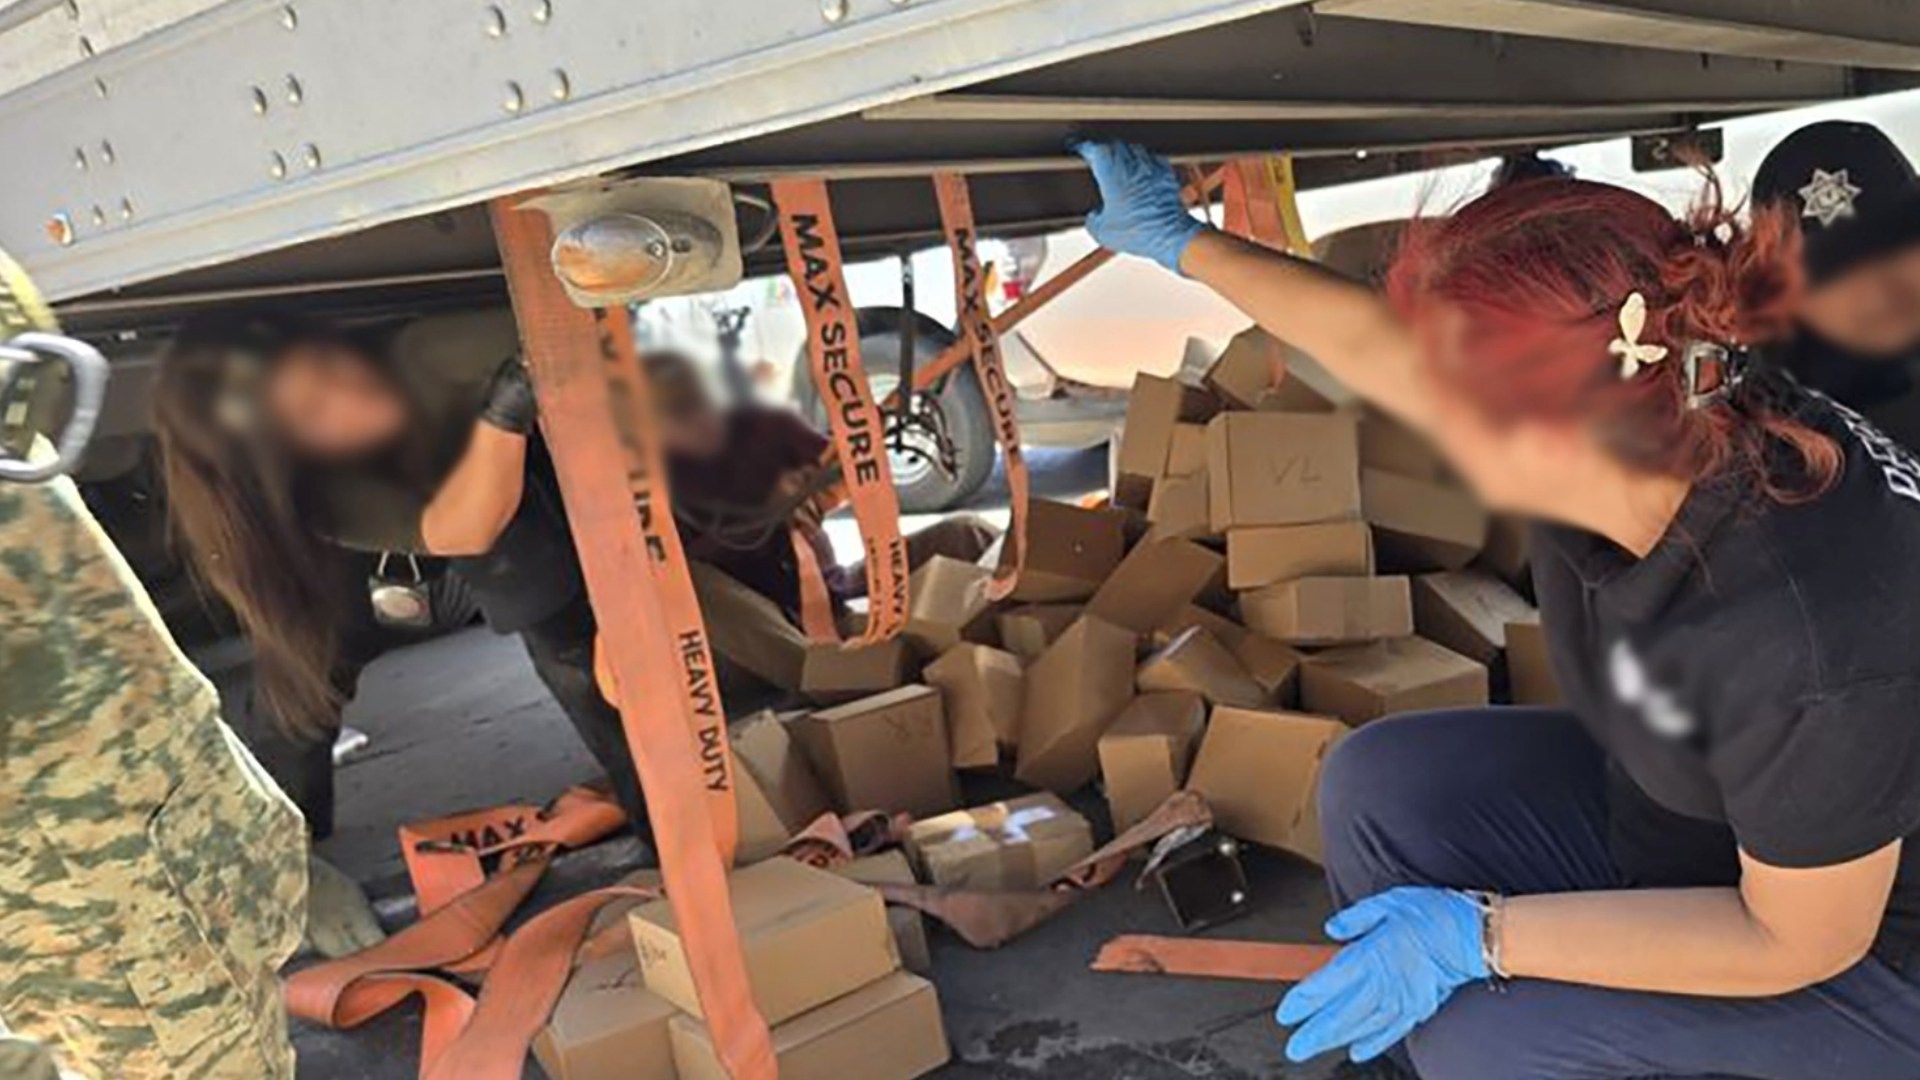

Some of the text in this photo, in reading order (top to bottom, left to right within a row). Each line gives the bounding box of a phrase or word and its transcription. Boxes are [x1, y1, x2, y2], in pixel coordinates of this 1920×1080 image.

[955, 228, 979, 313] MAX
[791, 214, 880, 486] MAX SECURE
[679, 630, 728, 791] HEAVY DUTY
[451, 815, 525, 849] MAX
